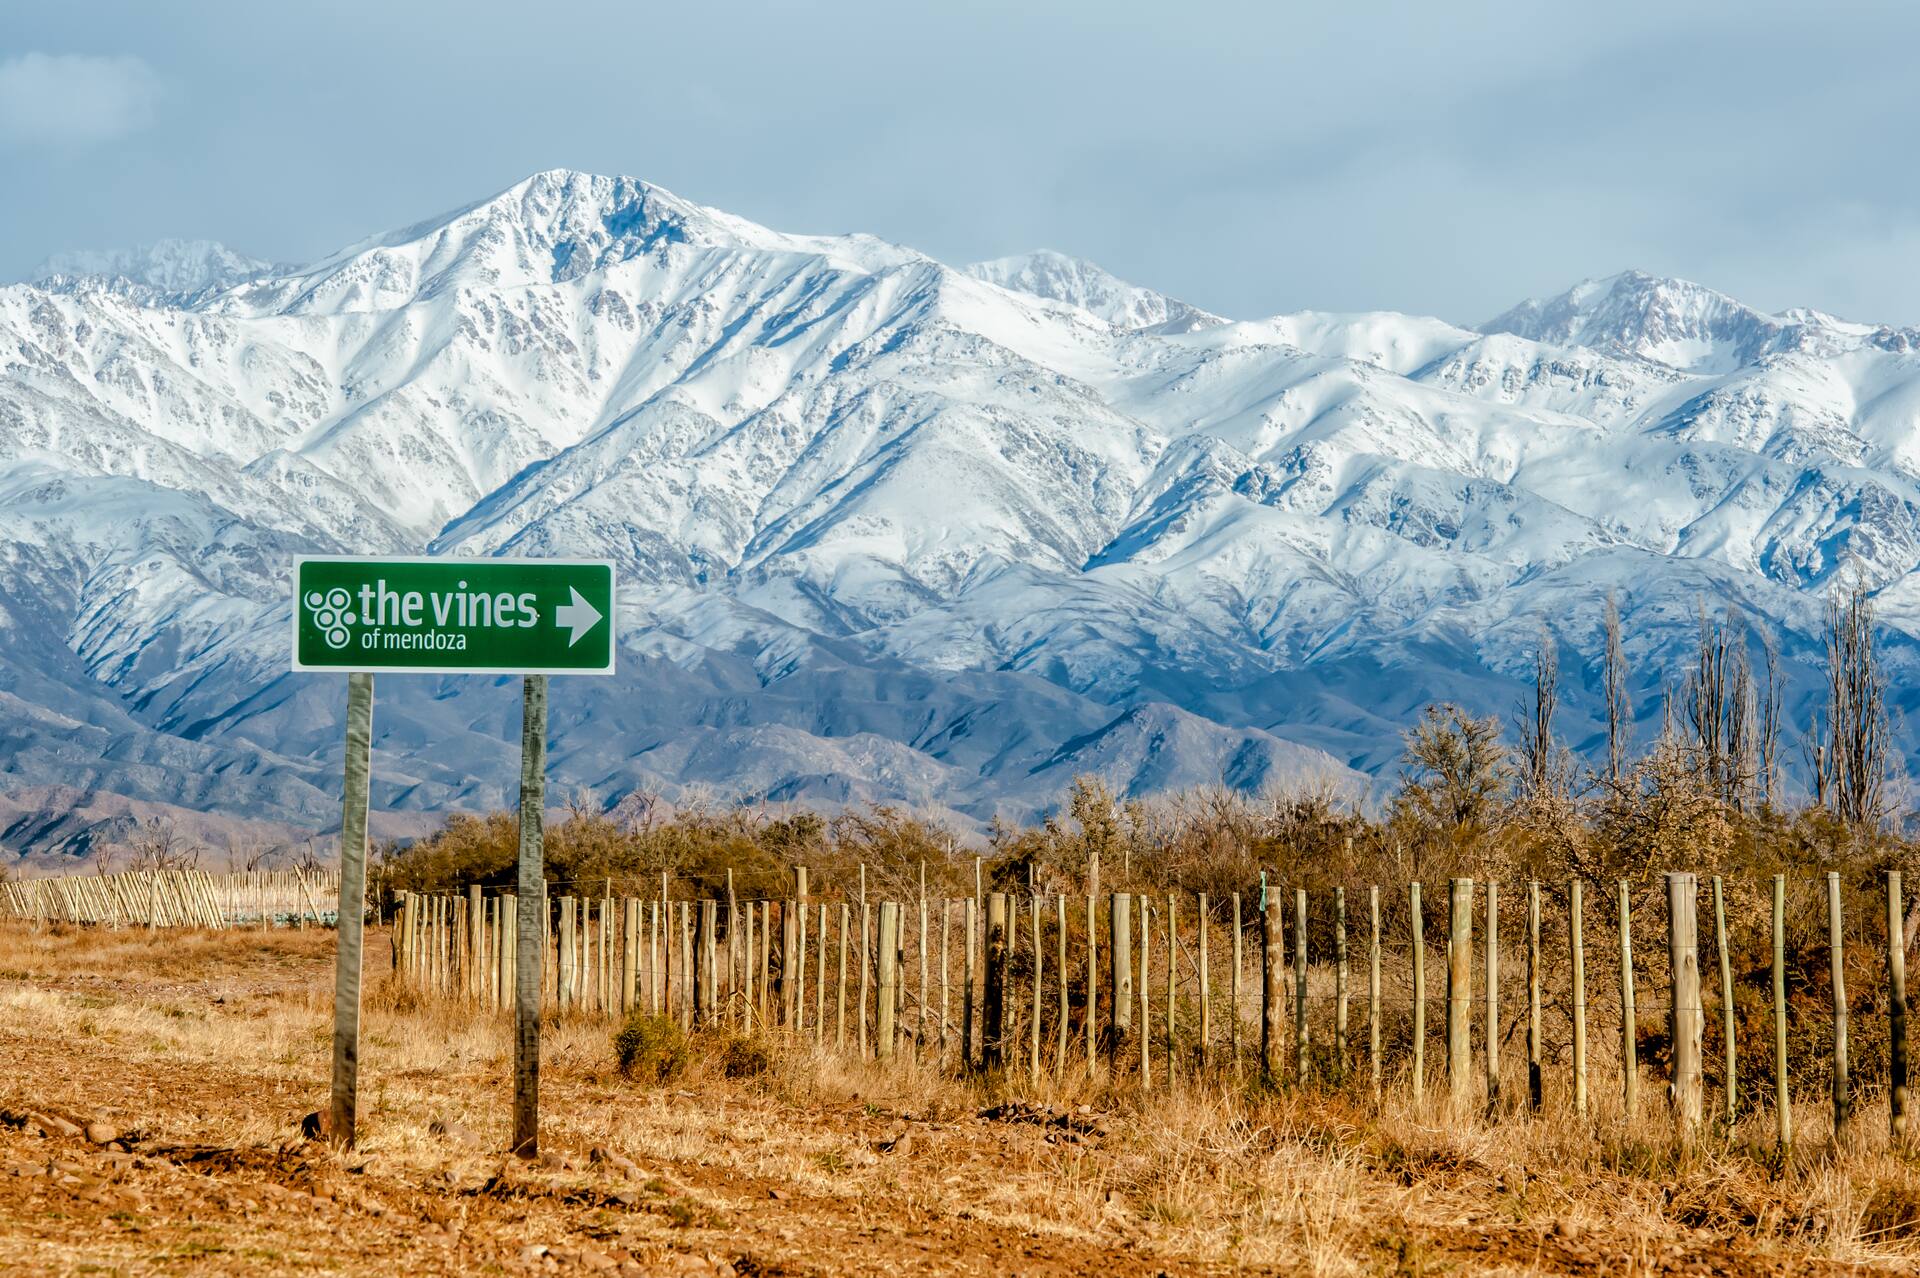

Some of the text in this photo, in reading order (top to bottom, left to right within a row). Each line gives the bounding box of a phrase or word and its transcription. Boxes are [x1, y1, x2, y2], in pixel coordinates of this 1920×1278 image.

[357, 579, 538, 628] the vines
[361, 628, 467, 650] of mendoza
